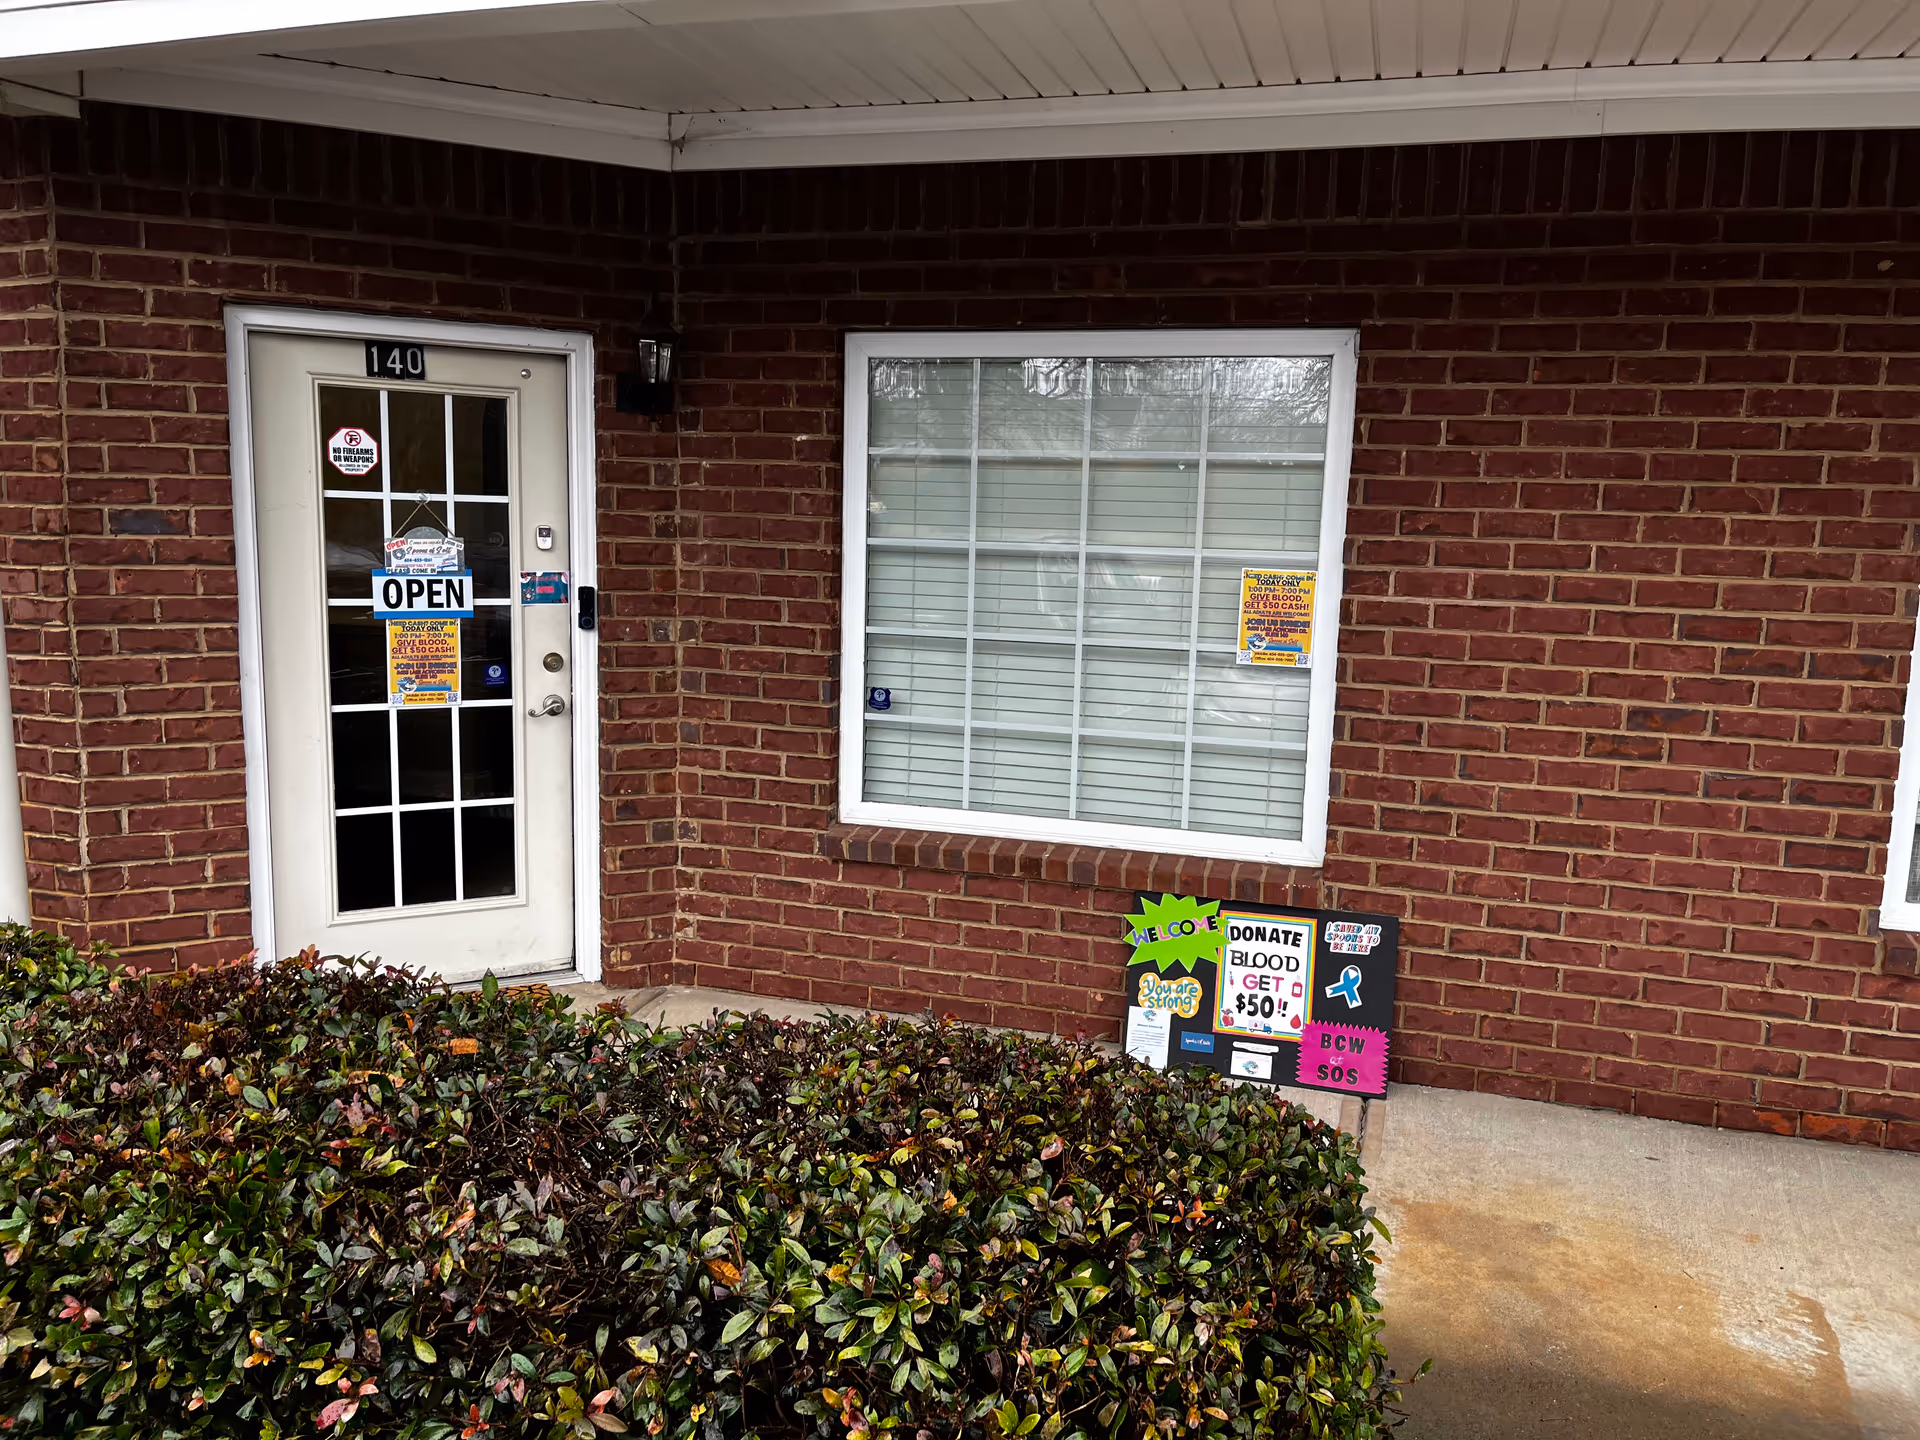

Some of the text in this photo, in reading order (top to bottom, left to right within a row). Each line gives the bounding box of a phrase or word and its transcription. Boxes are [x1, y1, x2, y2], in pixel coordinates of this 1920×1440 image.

[371, 345, 422, 374] 140
[332, 446, 374, 456] NO FIREARMS
[333, 454, 374, 464] OR WEAPONS
[386, 539, 406, 551] OPEN
[382, 578, 465, 609] OPEN
[1272, 594, 1304, 602] BLOOD,
[1262, 601, 1279, 609] $50
[1281, 602, 1309, 610] CASH!
[1132, 915, 1219, 946] WELCOME
[1230, 926, 1304, 948] DONATE
[1327, 923, 1380, 935] I SAVED MY
[1327, 932, 1379, 944] SPOONS TO
[1332, 942, 1369, 953] BE HERE
[1230, 949, 1300, 972] BLOOD
[1143, 978, 1198, 998] You are
[1242, 973, 1284, 992] GET
[1148, 994, 1192, 1013] strong
[1236, 992, 1288, 1019] $50!!
[1321, 1033, 1366, 1054] BCW
[1329, 1056, 1344, 1065] at
[1317, 1064, 1359, 1085] SOS
